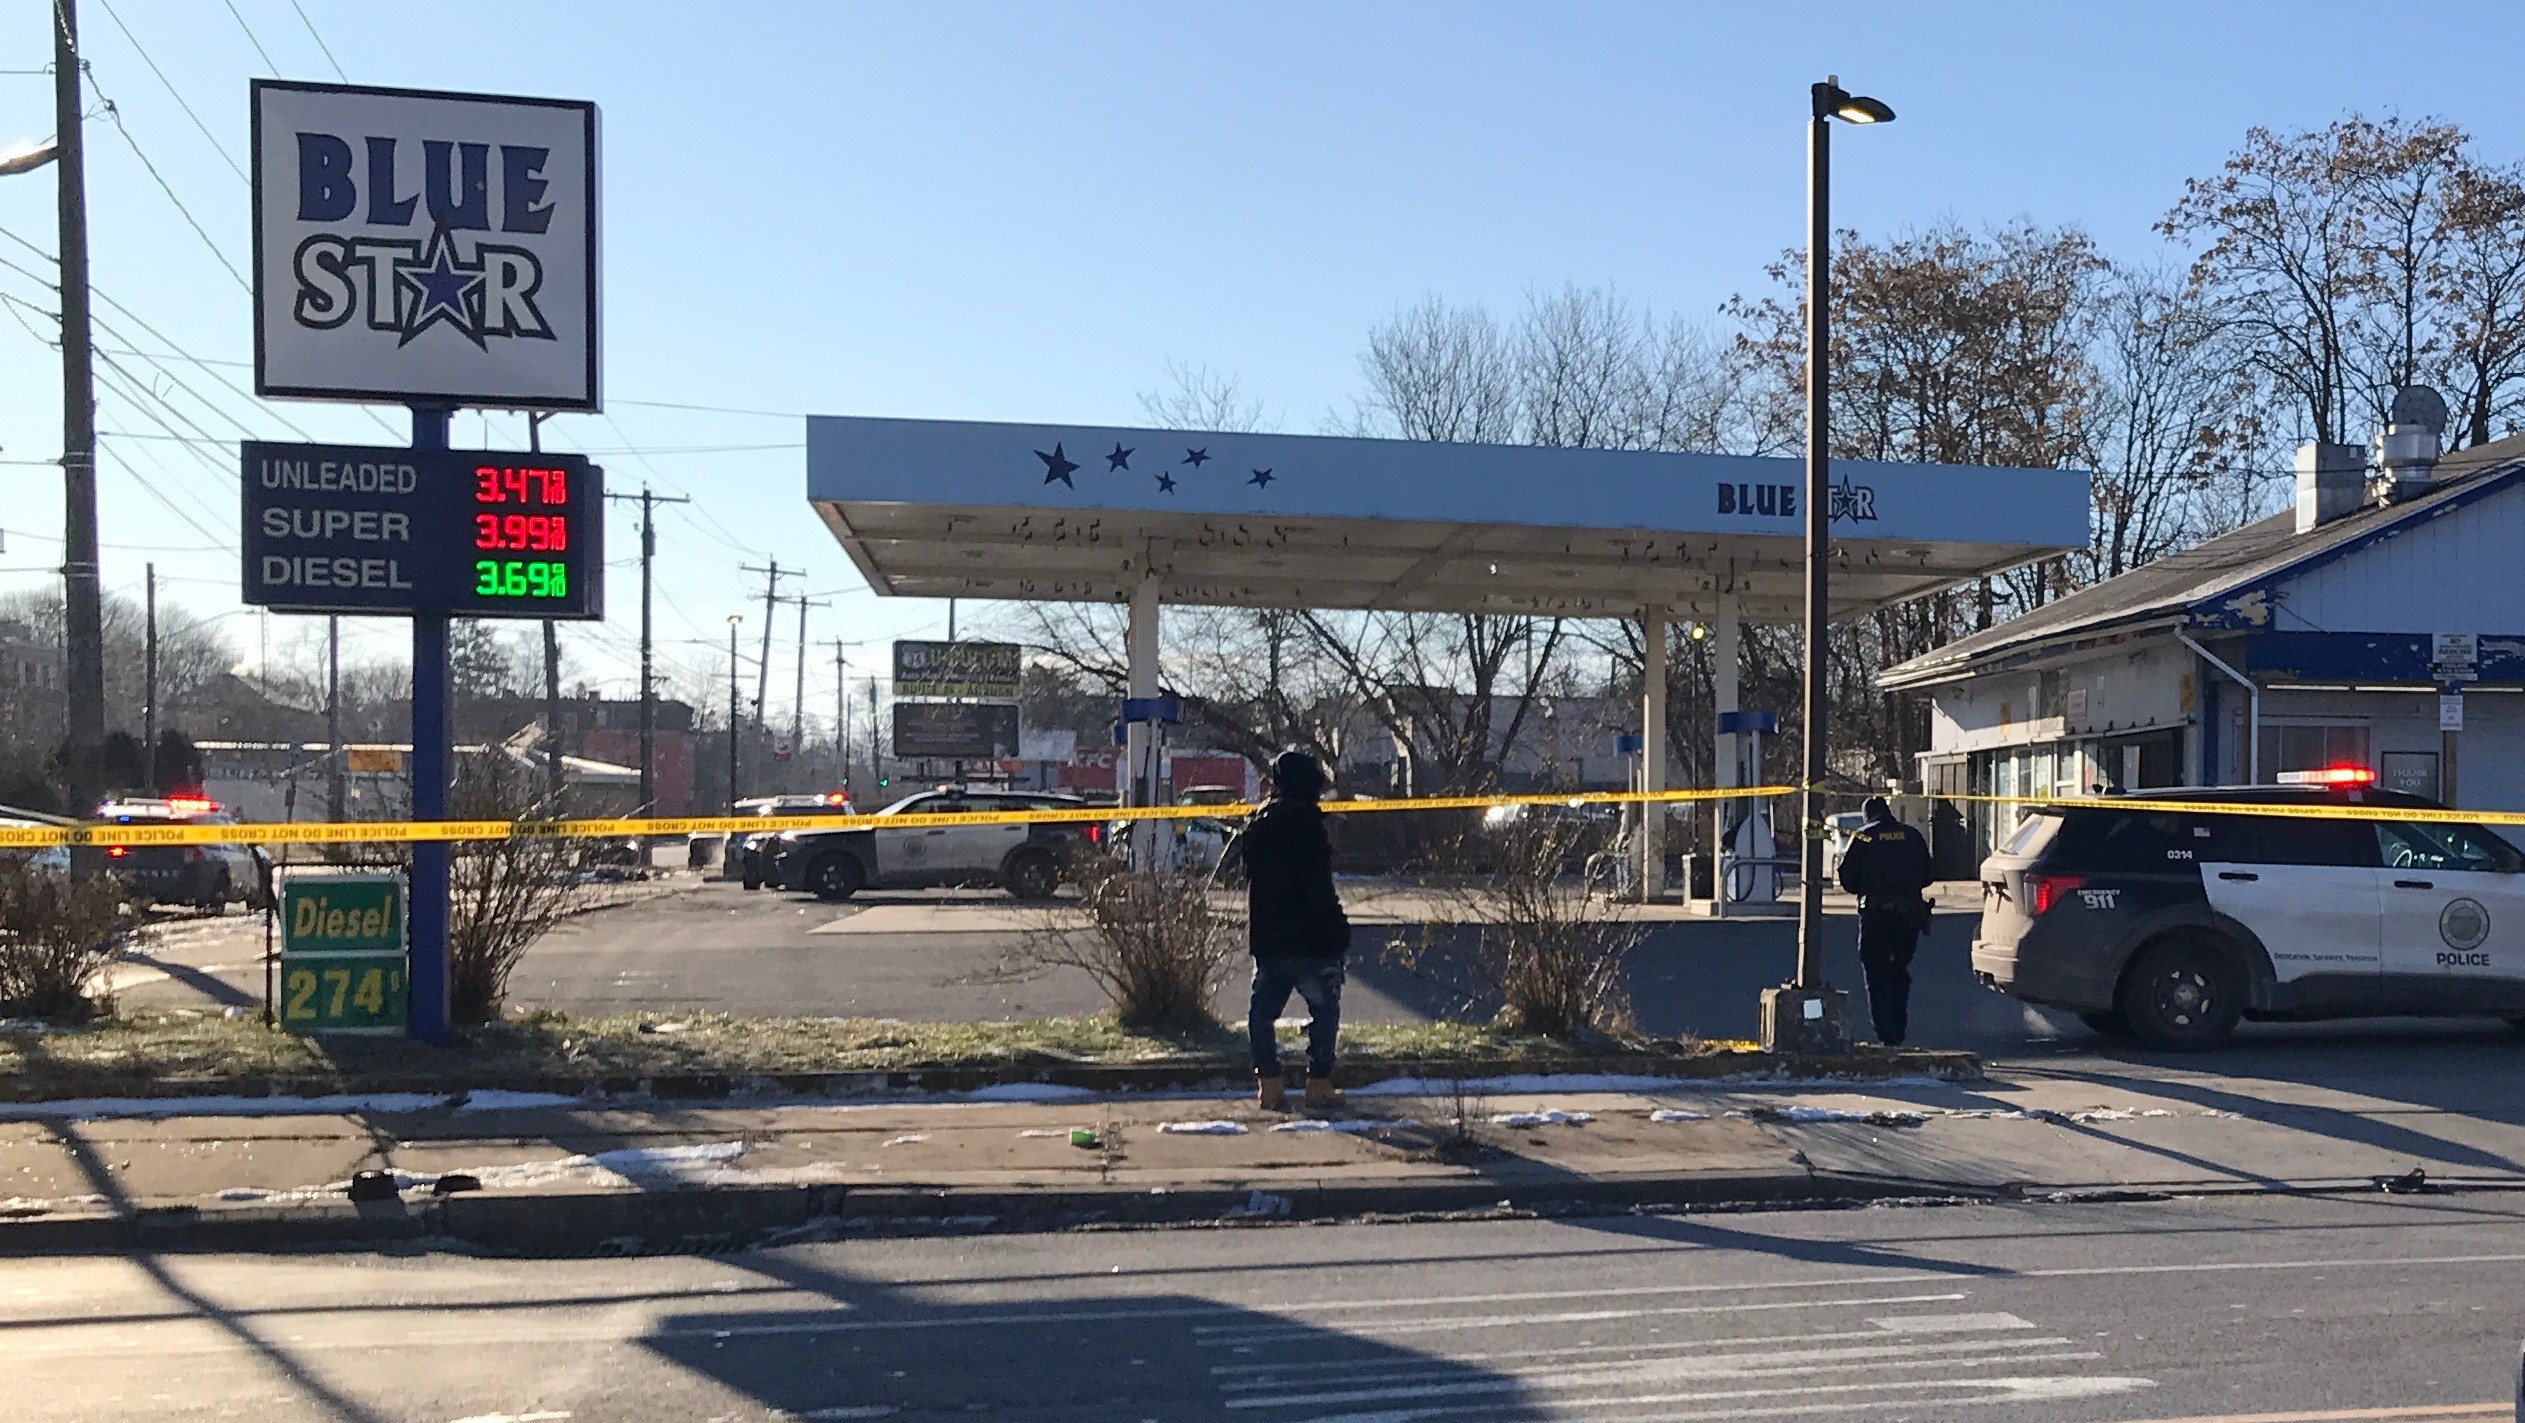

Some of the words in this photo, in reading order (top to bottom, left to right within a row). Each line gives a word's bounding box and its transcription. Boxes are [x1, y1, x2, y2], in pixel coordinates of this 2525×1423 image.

[295, 131, 558, 234] BLUE
[294, 207, 558, 353] STAR
[262, 459, 417, 494] UNLEADED
[475, 467, 549, 504] 3.47
[1717, 483, 1796, 517] BLUE
[1828, 474, 1878, 526] TAR
[263, 507, 410, 541] SUPER
[475, 514, 549, 550] 3.99
[262, 556, 413, 589] DIESEL
[475, 561, 550, 596] 3.69
[1068, 751, 1112, 768] KFC
[2393, 768, 2428, 778] THANK
[2400, 779, 2421, 787] YOU
[441, 825, 484, 836] CROSS
[489, 825, 511, 835] NOT
[517, 824, 534, 835] DO
[539, 824, 567, 834] LINE
[571, 823, 615, 833] POLICE
[647, 822, 687, 832] CROSS
[690, 822, 716, 831] NOT
[719, 822, 735, 830] DO
[739, 821, 765, 830] LINE
[770, 819, 811, 829] POLICE
[0, 830, 35, 843] CROS
[40, 830, 69, 843] NOT
[74, 830, 93, 843] DO
[100, 830, 130, 843] LINE
[135, 829, 185, 842] POLICE
[221, 828, 265, 840] CROSS
[271, 828, 298, 840] NOT
[303, 828, 321, 839] DO
[326, 827, 356, 839] LINE
[360, 826, 407, 838] POLICE
[1879, 831, 1905, 841] POLICE
[2167, 850, 2193, 859] 0314
[2084, 895, 2116, 909] 911
[293, 895, 393, 938] Diesel
[2436, 952, 2491, 967] POLICE
[286, 968, 384, 1019] 274
